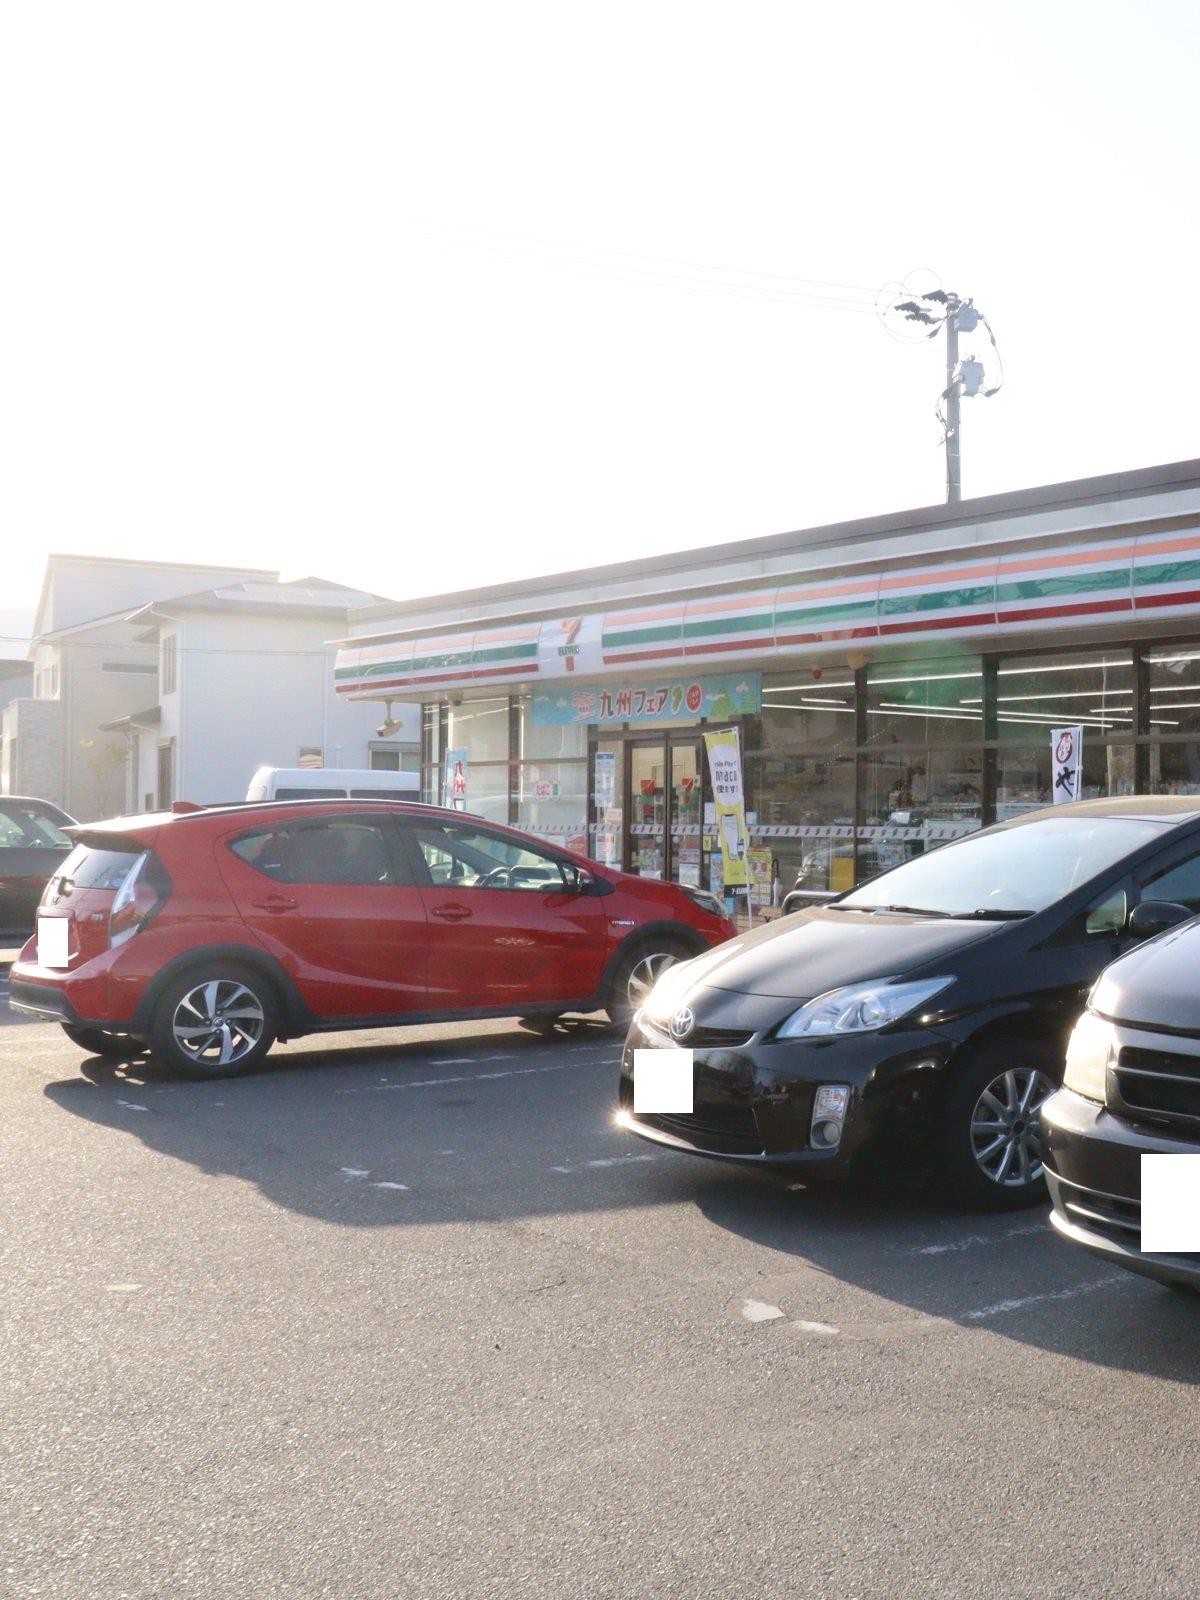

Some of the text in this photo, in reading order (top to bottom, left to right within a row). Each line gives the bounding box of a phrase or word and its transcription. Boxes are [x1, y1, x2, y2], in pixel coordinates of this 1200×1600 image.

[600, 688, 669, 718] 九州フェア
